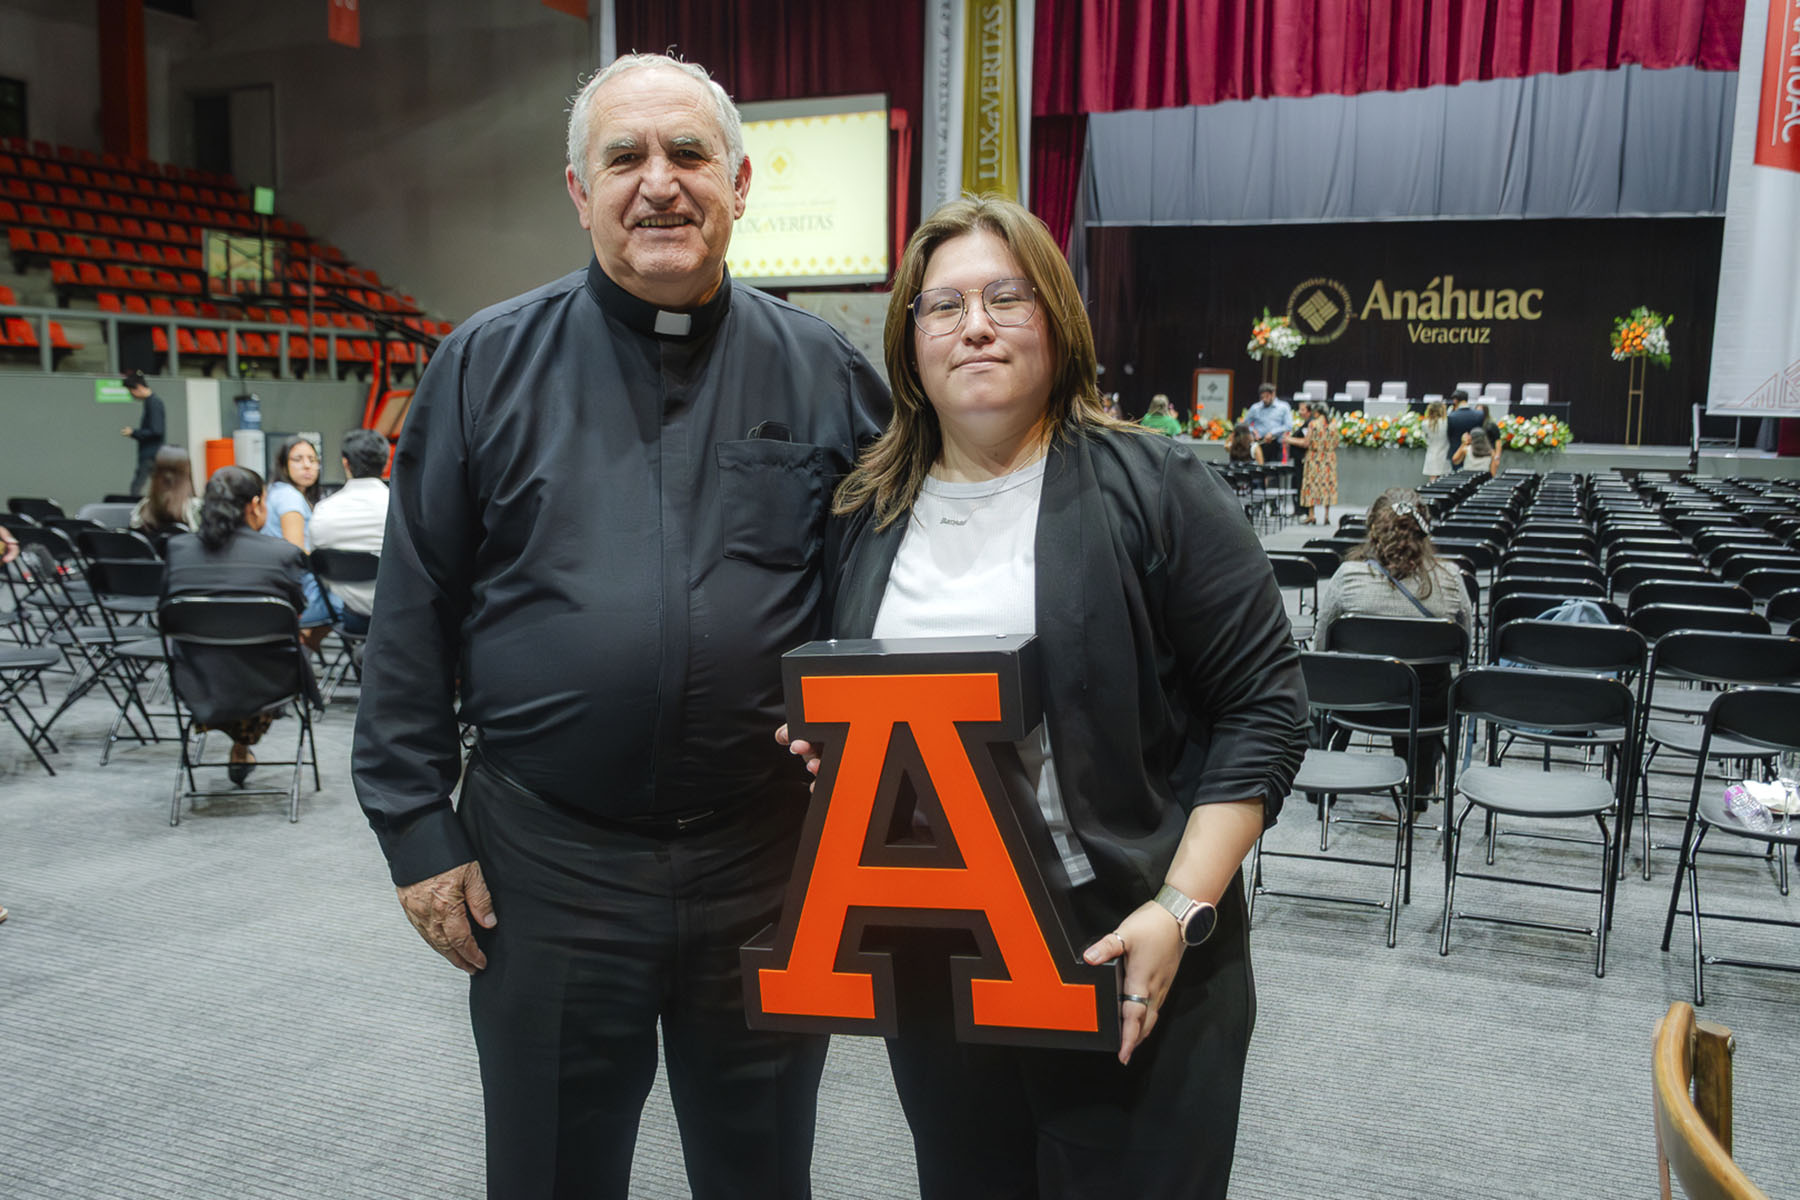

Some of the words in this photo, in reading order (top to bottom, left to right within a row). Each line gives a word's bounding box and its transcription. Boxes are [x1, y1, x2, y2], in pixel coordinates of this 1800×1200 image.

[980, 4, 1003, 113] VERITAS
[979, 128, 1000, 180] LUX
[736, 216, 762, 234] UX
[768, 213, 834, 233] VERITAS
[1360, 275, 1544, 321] Anáhuac
[1407, 322, 1490, 344] Veracruz
[758, 673, 1099, 1032] A
